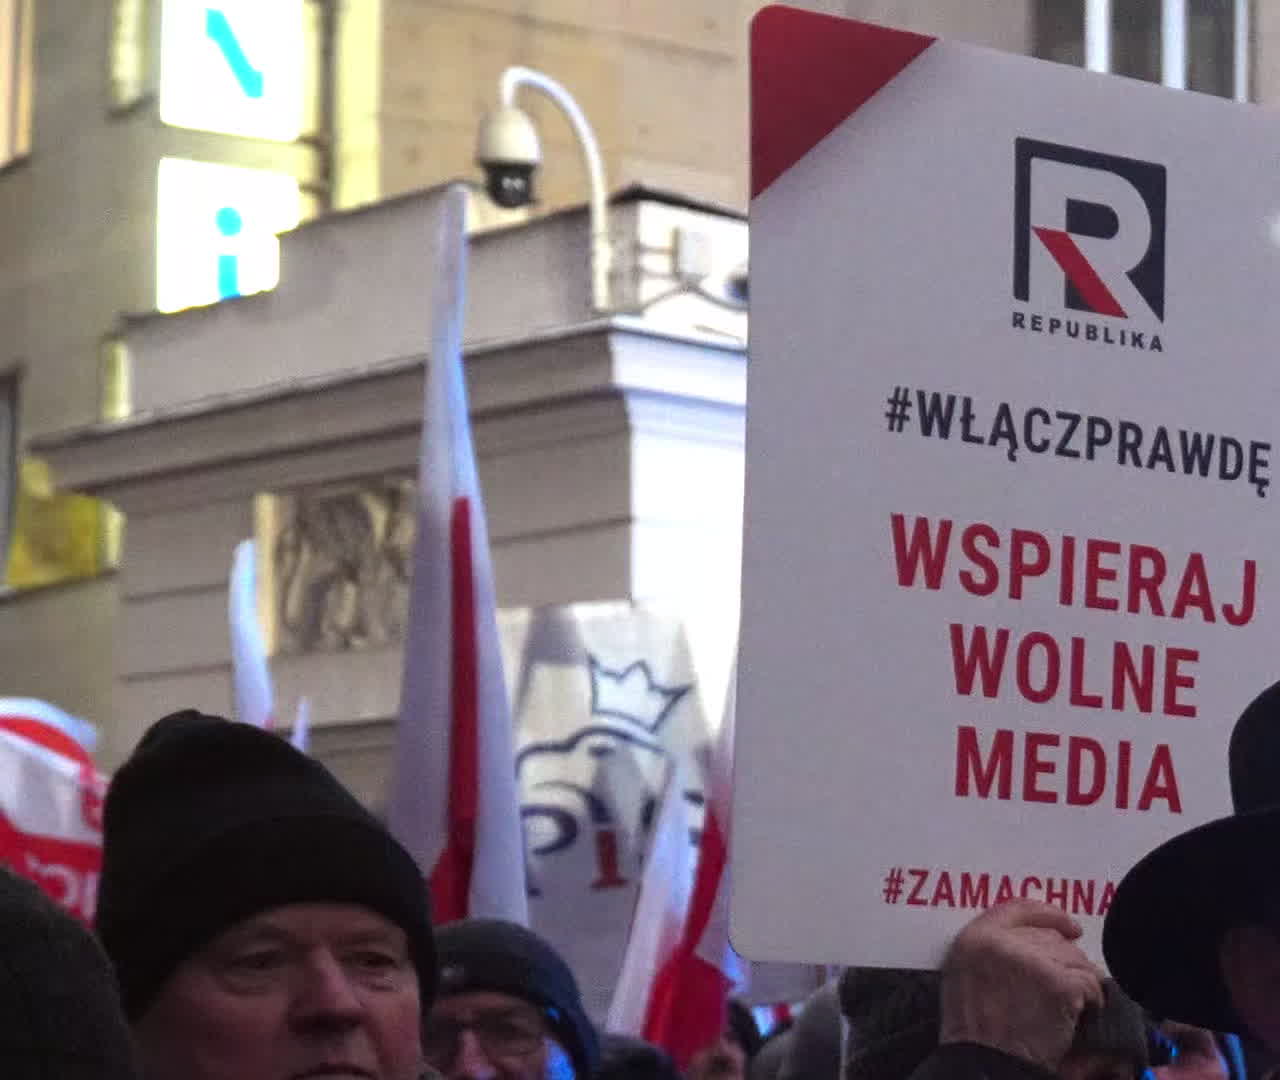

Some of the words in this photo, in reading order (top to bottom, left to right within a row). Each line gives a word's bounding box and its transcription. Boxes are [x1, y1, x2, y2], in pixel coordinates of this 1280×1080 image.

[1012, 311, 1163, 353] REPUBLIKA
[885, 386, 1271, 498] #WŁĄCZPRAWDĘ
[890, 512, 1256, 627] WSPIERAJ
[949, 623, 1199, 719] WOLNE
[954, 725, 1182, 815] MEDIA
